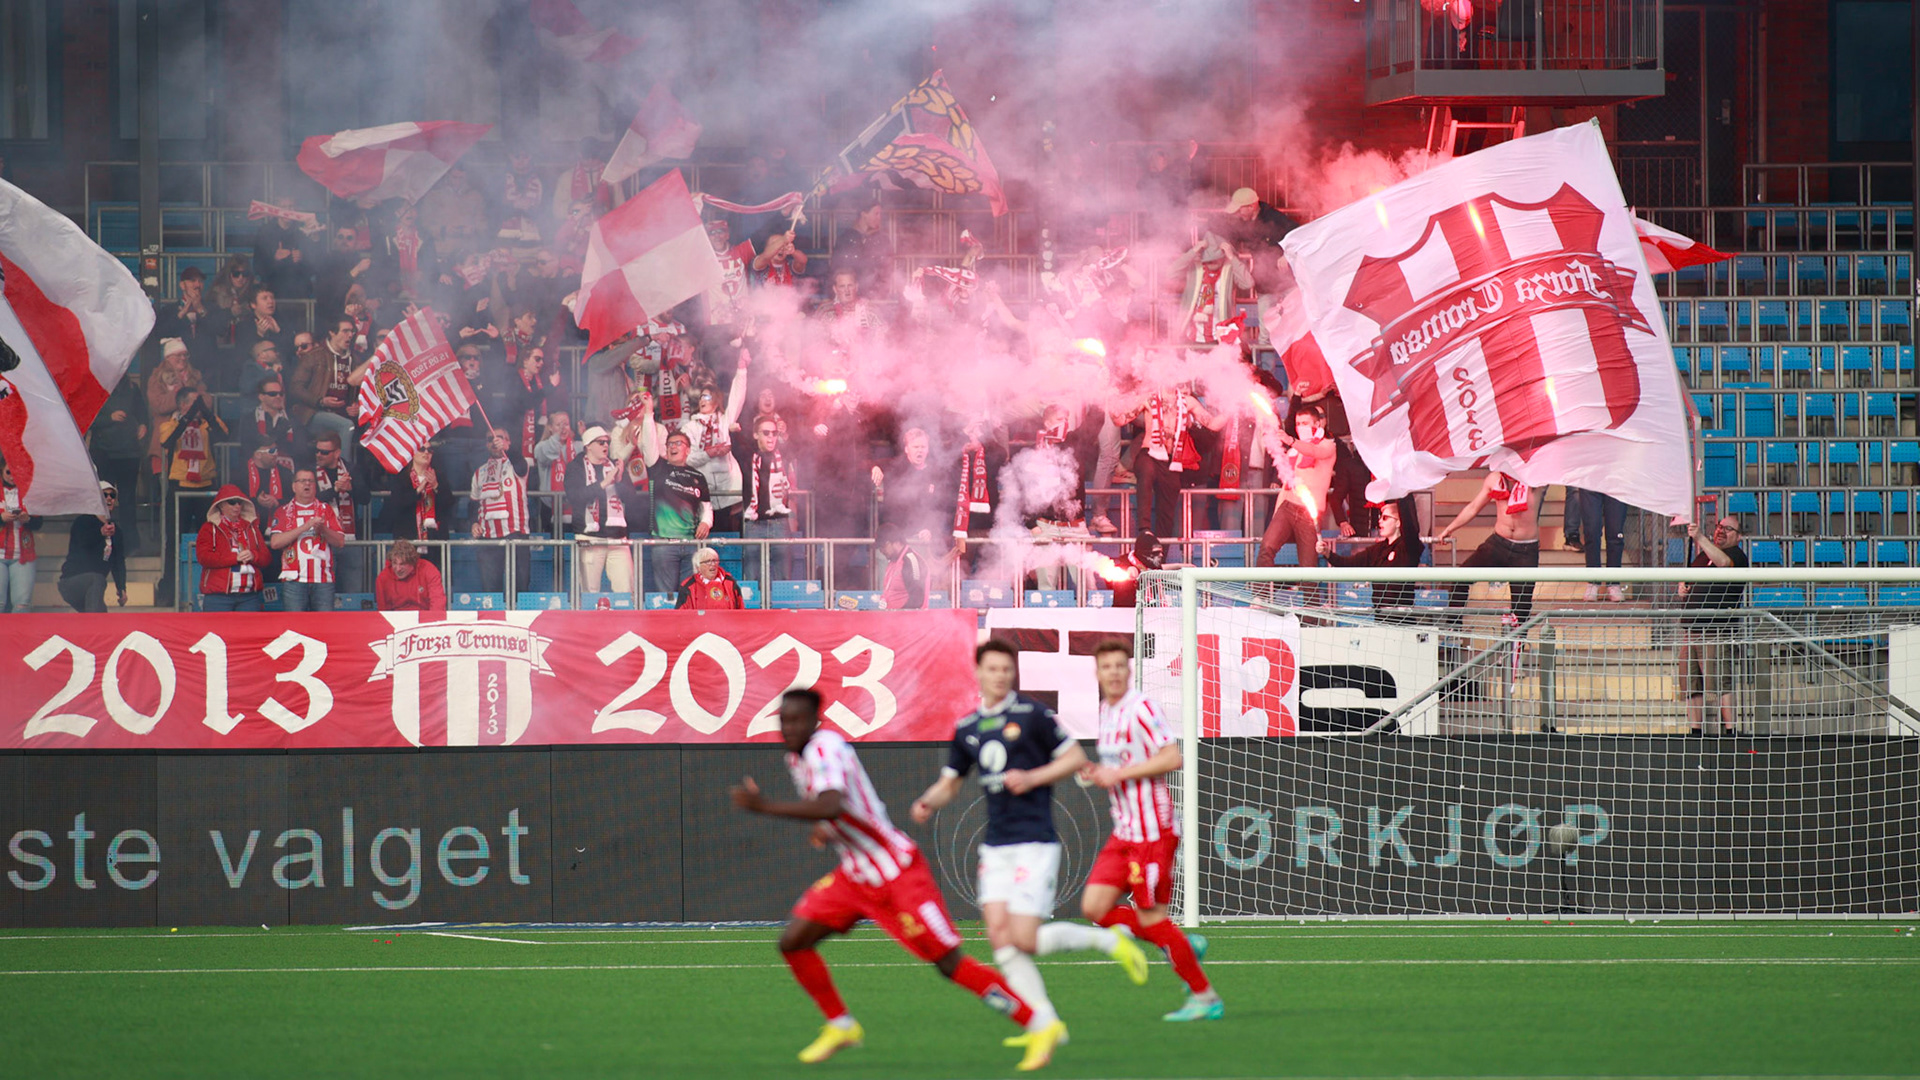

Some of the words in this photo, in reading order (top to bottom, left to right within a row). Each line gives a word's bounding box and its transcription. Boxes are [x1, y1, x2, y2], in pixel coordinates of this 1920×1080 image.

[23, 629, 334, 740] 2013
[396, 633, 452, 660] Forza
[455, 629, 528, 653] Tromsø
[591, 630, 898, 738] 2023
[486, 672, 500, 735] 2013
[7, 811, 161, 891] ste
[208, 806, 531, 910] valget
[1213, 802, 1611, 871] ØRKJØP
